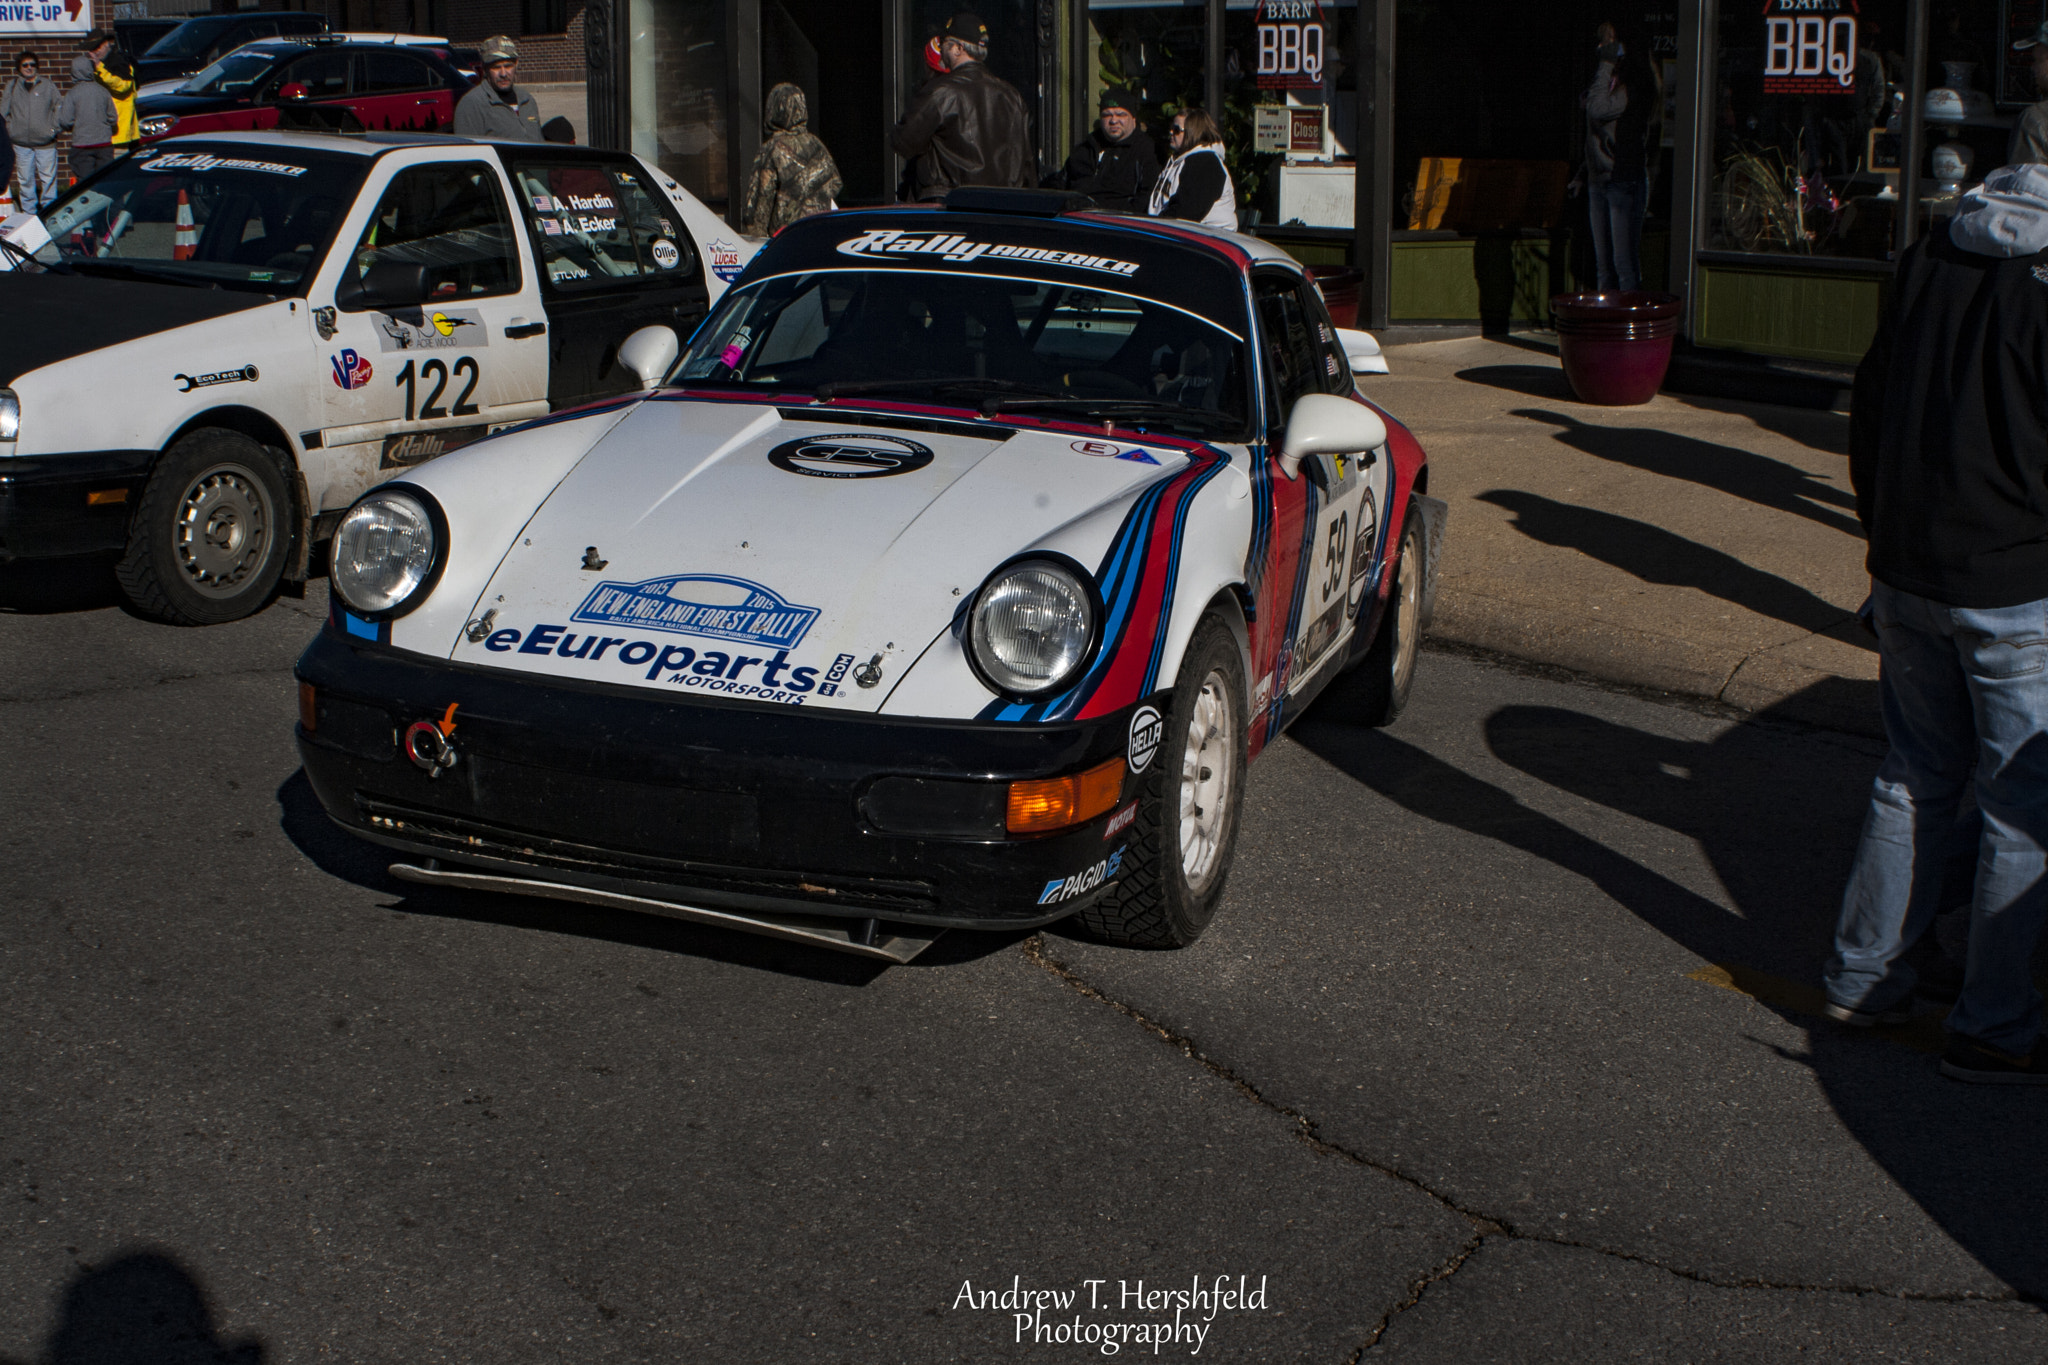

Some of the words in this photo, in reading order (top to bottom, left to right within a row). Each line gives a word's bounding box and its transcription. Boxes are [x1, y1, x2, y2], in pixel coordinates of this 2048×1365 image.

[1267, 2, 1312, 19] BARN
[1257, 23, 1323, 83] BBQ
[1764, 16, 1856, 87] BBQ
[140, 153, 225, 172] Rally
[221, 159, 307, 177] AMERICA
[552, 195, 569, 212] A.
[568, 193, 614, 211] Hardin
[562, 218, 578, 235] A.
[578, 216, 617, 233] Ecker
[654, 246, 677, 260] Ollie
[714, 254, 738, 265] LUCAS
[837, 230, 992, 262] Rally
[987, 244, 1140, 276] AMERICA
[195, 370, 240, 383] EcoTech
[330, 348, 359, 390] VP
[396, 356, 480, 421] 122
[389, 435, 446, 462] Rally
[796, 444, 903, 469] GPS
[1083, 442, 1107, 455] E
[796, 468, 857, 478] SERVICE
[1322, 510, 1348, 603] 59
[639, 582, 670, 596] 2015
[747, 592, 776, 611] 2015
[587, 586, 630, 616] NEW
[622, 594, 697, 624] ENGLAND
[692, 604, 751, 630] FOREST
[747, 609, 810, 639] RALLY
[608, 616, 633, 624] RALLY
[630, 618, 665, 629] AMERICA
[701, 627, 760, 641] CHAMPIONSHIP
[485, 623, 821, 693] eEuroparts
[829, 654, 853, 681] COM
[666, 672, 808, 706] MOTORSPORTS
[1131, 720, 1163, 756] HELLA
[1104, 803, 1137, 838] MOTUL
[1059, 859, 1107, 902] PAGID
